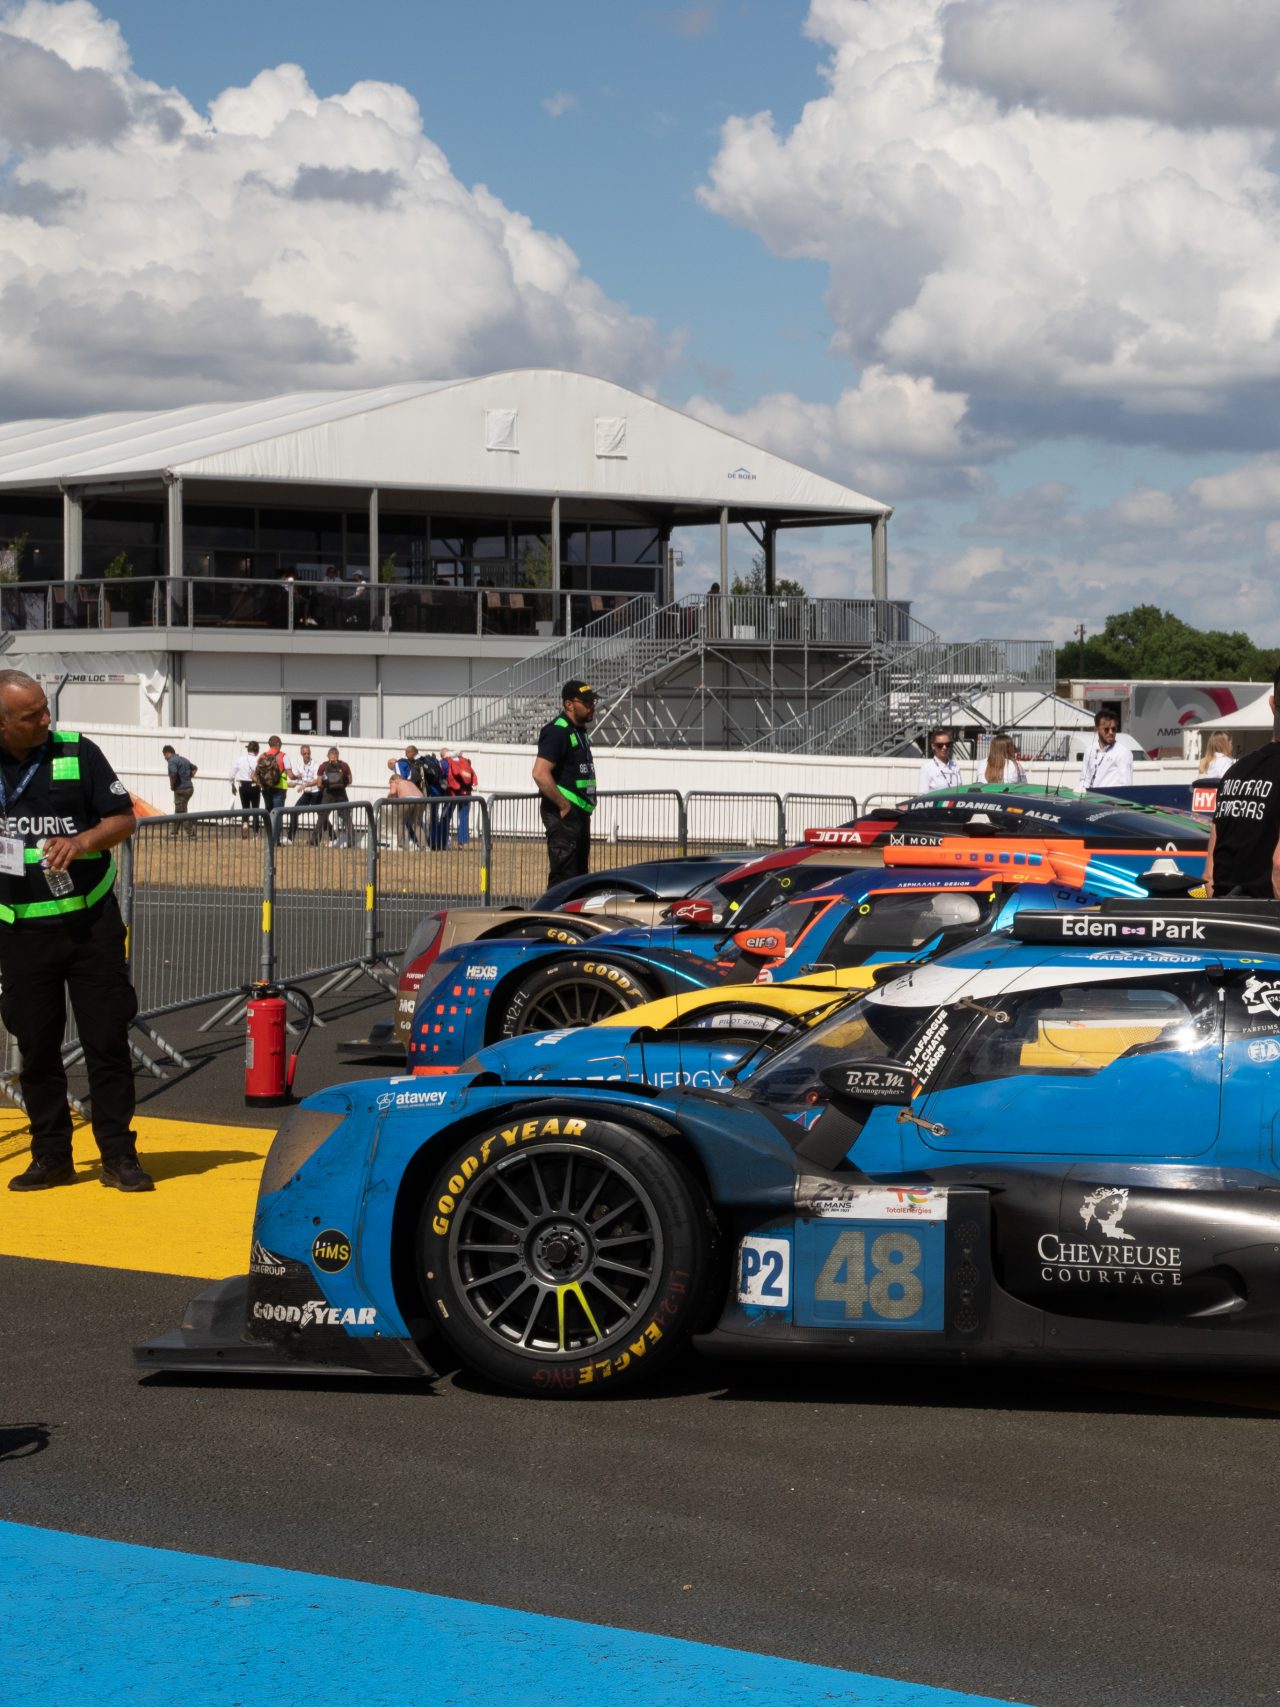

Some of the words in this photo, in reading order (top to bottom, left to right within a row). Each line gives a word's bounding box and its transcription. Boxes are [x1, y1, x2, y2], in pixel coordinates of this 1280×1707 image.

[1195, 791, 1216, 808] HY
[910, 801, 935, 810] IAN
[956, 801, 1004, 812] DANIEL
[1025, 809, 1062, 823] ALEX
[813, 831, 863, 843] JOTA
[1061, 915, 1117, 936] Eden
[1151, 918, 1206, 939] Park
[746, 936, 766, 948] elf
[465, 965, 498, 978] HEXIS
[909, 1008, 949, 1061] LAFARGUE
[1242, 1023, 1278, 1034] PARFUMS
[921, 1022, 949, 1062] CHATIN
[395, 1091, 448, 1106] atawey
[432, 1118, 588, 1236] GOODYEAR
[823, 1201, 853, 1209] MANS
[886, 1206, 932, 1215] TotalEnergies
[260, 1264, 286, 1276] GROUP
[740, 1247, 783, 1297] P2
[814, 1229, 924, 1320] 48
[1040, 1266, 1183, 1286] COURTAGE
[253, 1300, 377, 1329] GOODYEAR
[579, 1321, 664, 1384] EAGLE
